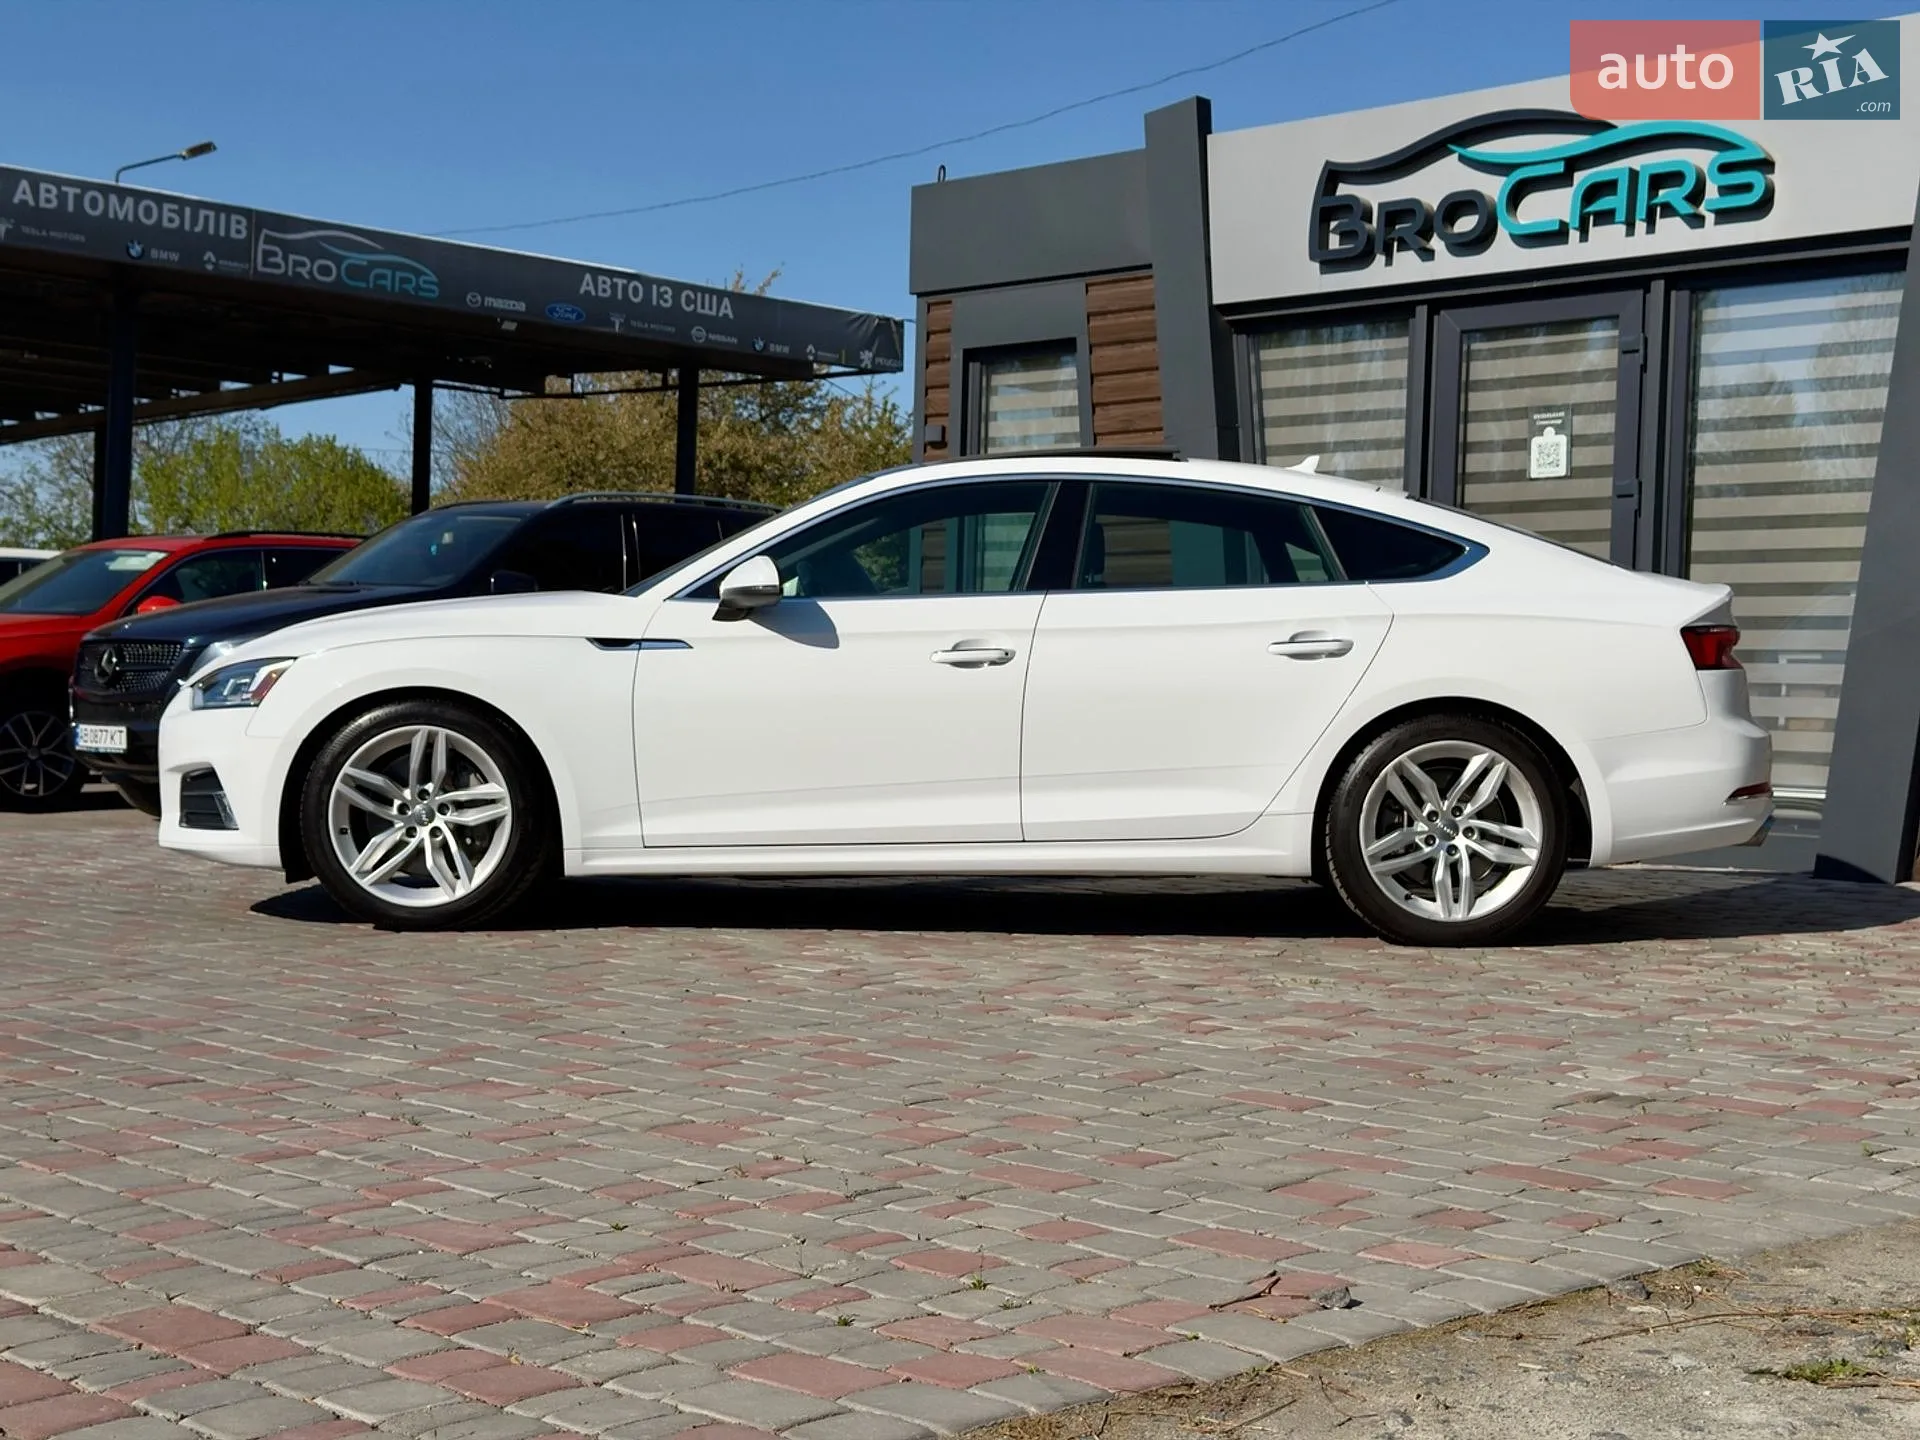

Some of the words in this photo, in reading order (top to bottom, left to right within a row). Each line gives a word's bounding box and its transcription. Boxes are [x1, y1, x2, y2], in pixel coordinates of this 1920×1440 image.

[12, 179, 248, 241] АВТОМОБІЛІВ
[150, 247, 180, 262] BMW
[484, 295, 526, 312] mazda
[579, 272, 643, 304] АВТО
[652, 286, 673, 309] ІЗ
[680, 290, 734, 319] США
